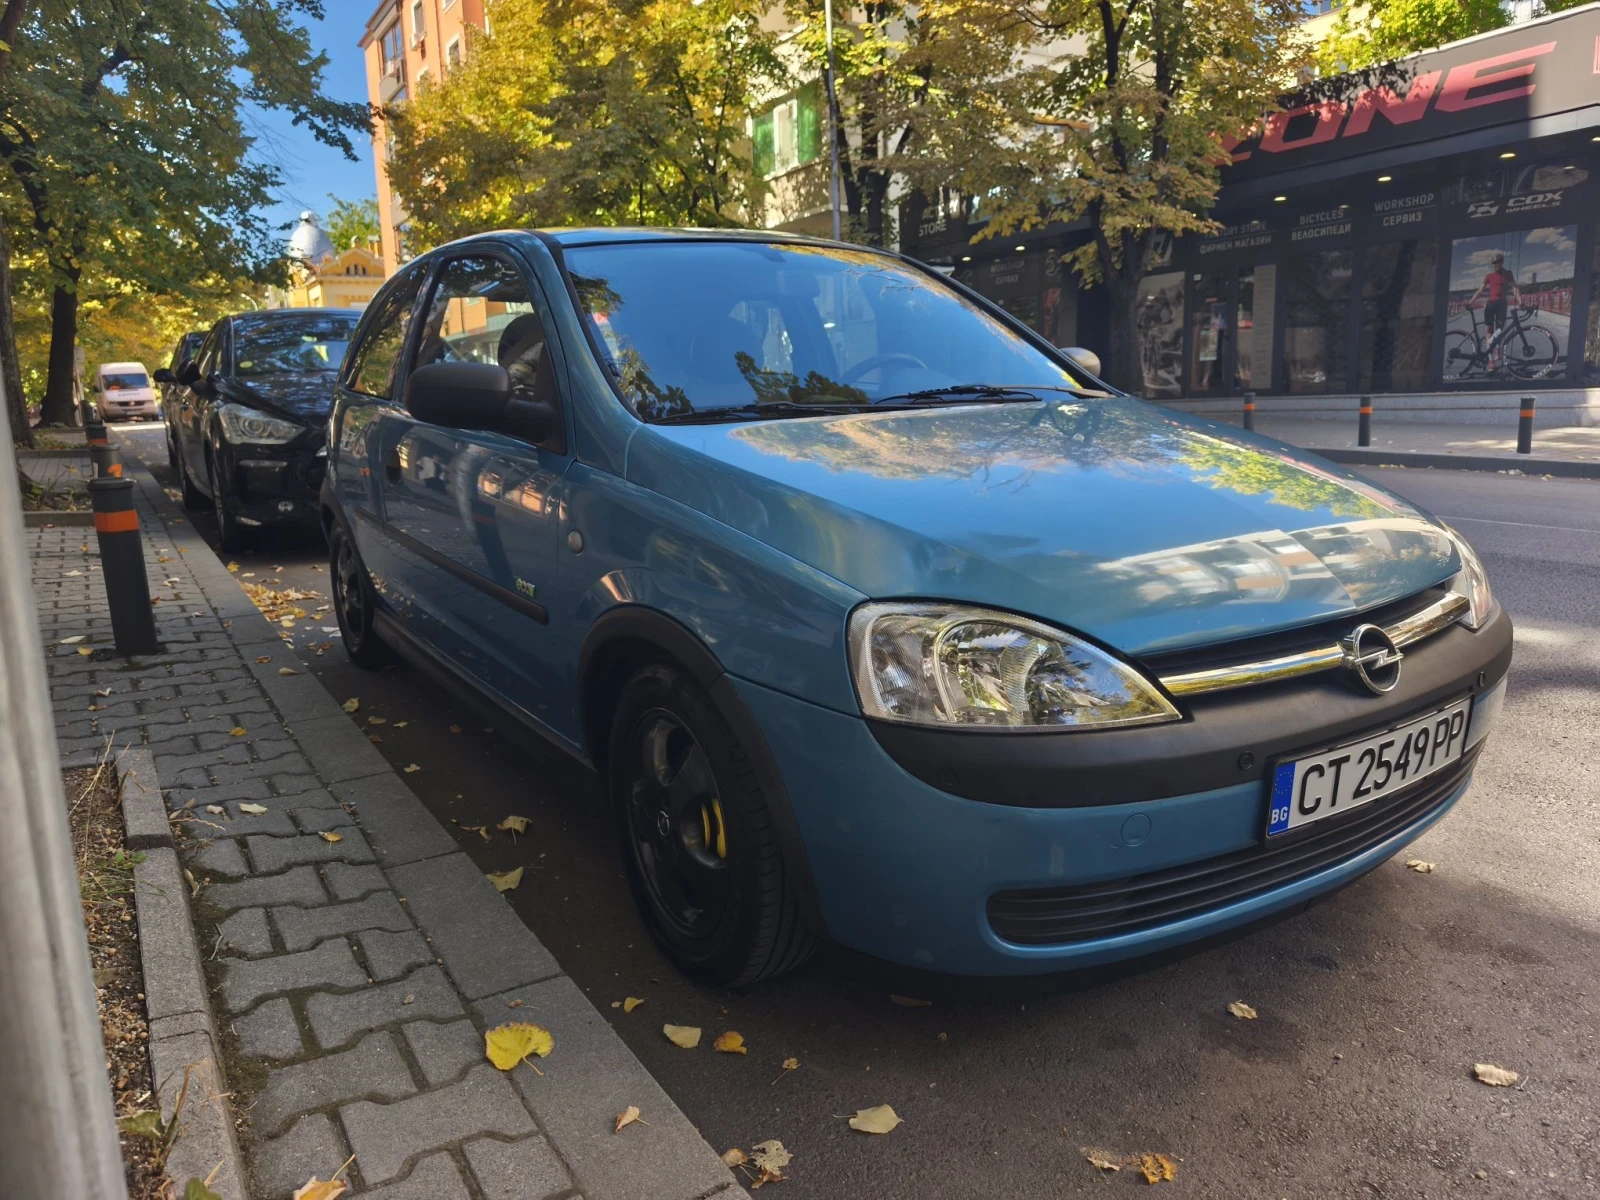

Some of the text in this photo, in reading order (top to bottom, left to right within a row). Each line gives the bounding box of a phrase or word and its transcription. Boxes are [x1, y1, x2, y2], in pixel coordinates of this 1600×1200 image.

[1374, 193, 1434, 212] WORKSHOP
[1507, 191, 1564, 206] COX
[1299, 209, 1344, 225] BICYCLES
[1383, 212, 1422, 227] СЕРВИЗ
[1204, 225, 1239, 239] TORY
[1291, 223, 1351, 241] ВЕЛОСИПЕДИ
[1200, 235, 1272, 254] ФИРМЕН МАГАЗИН
[1298, 709, 1465, 815] CT 2549 PP
[1270, 808, 1288, 825] BG
